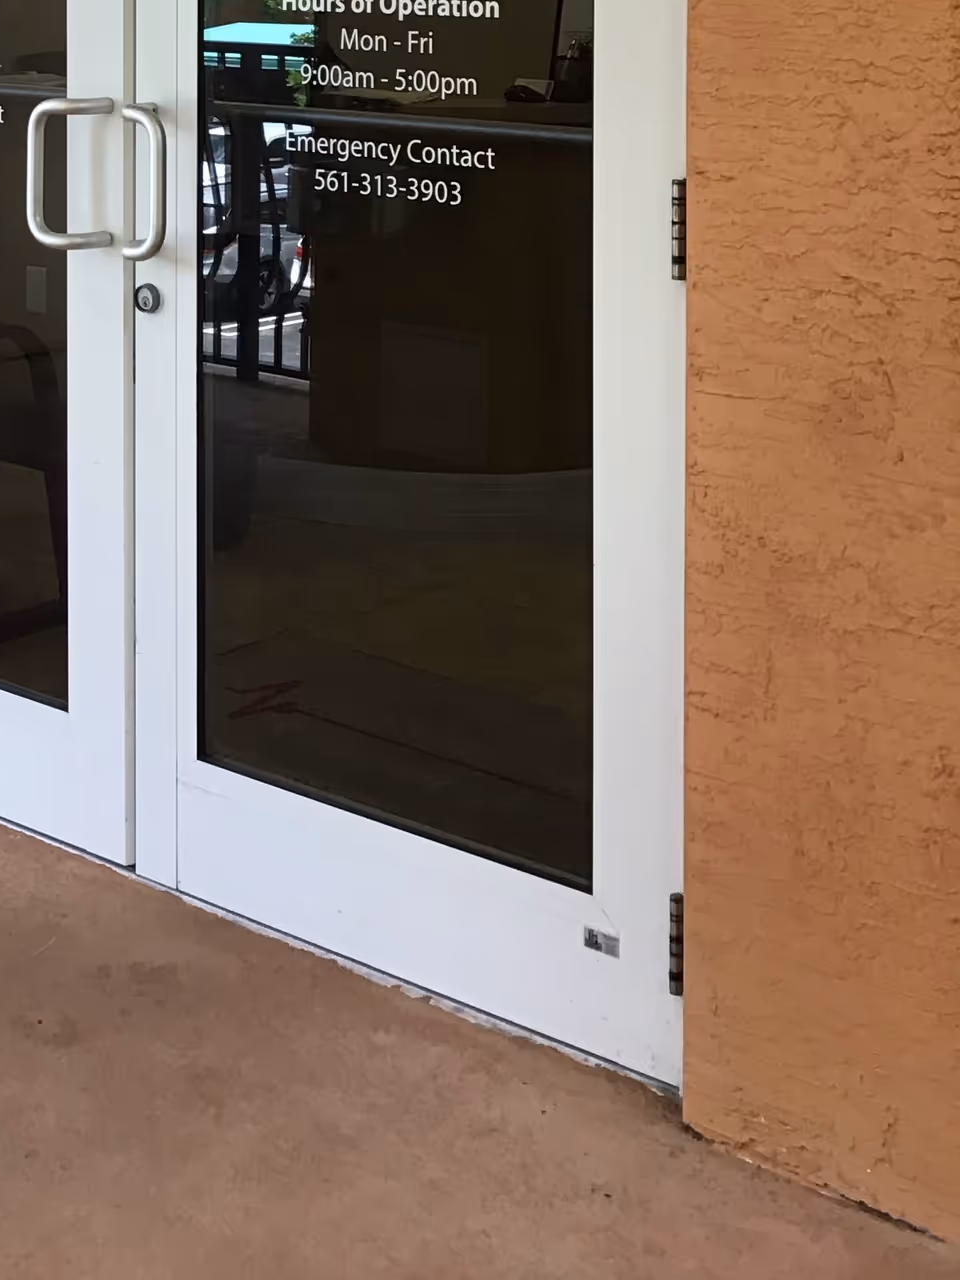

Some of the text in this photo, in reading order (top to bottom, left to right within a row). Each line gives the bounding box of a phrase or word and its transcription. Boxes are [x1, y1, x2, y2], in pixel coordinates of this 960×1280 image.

[340, 28, 387, 52] Mon
[408, 31, 433, 54] Fri
[300, 64, 374, 88] 9:00am
[394, 69, 477, 100] 5:00pm
[286, 130, 495, 170] Emergency Contact
[313, 169, 462, 205] 561-313-3903
